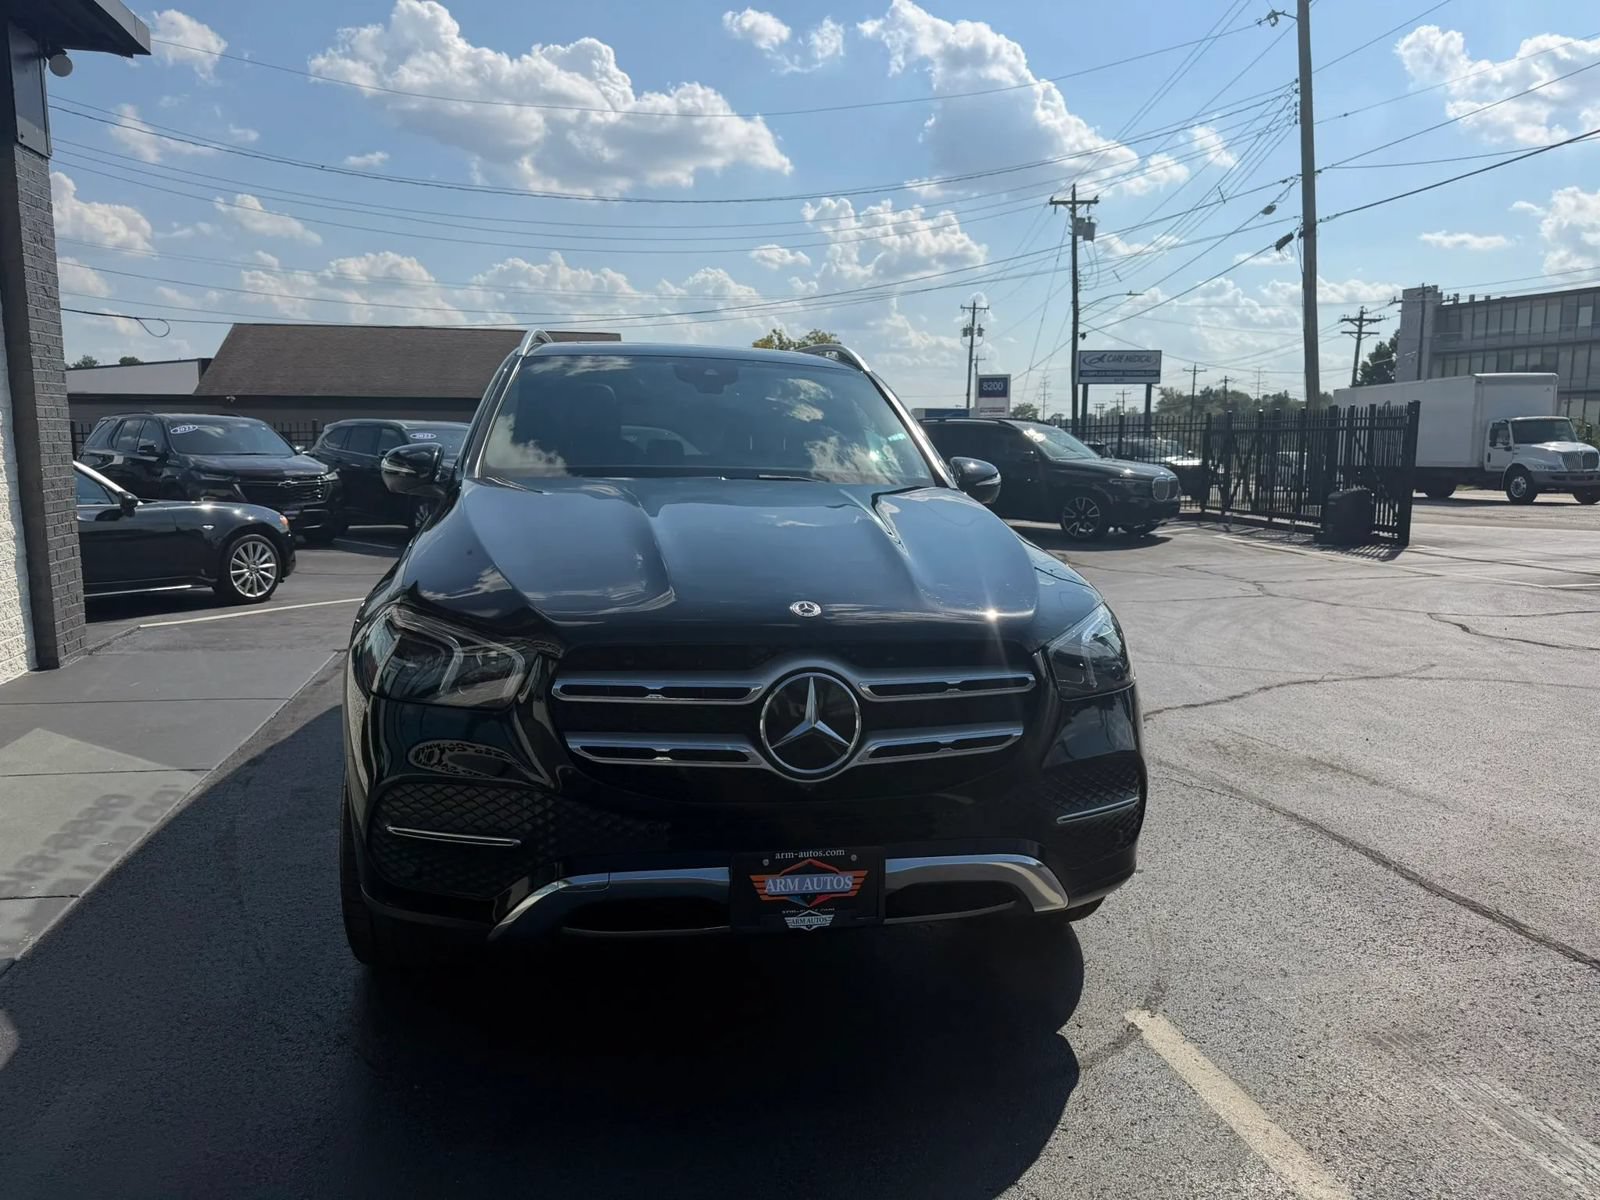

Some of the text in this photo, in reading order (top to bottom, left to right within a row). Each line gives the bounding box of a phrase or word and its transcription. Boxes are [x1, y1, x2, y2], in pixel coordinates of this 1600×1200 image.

[775, 849, 845, 859] arm-autos.com
[764, 876, 853, 893] ARM AUTOS
